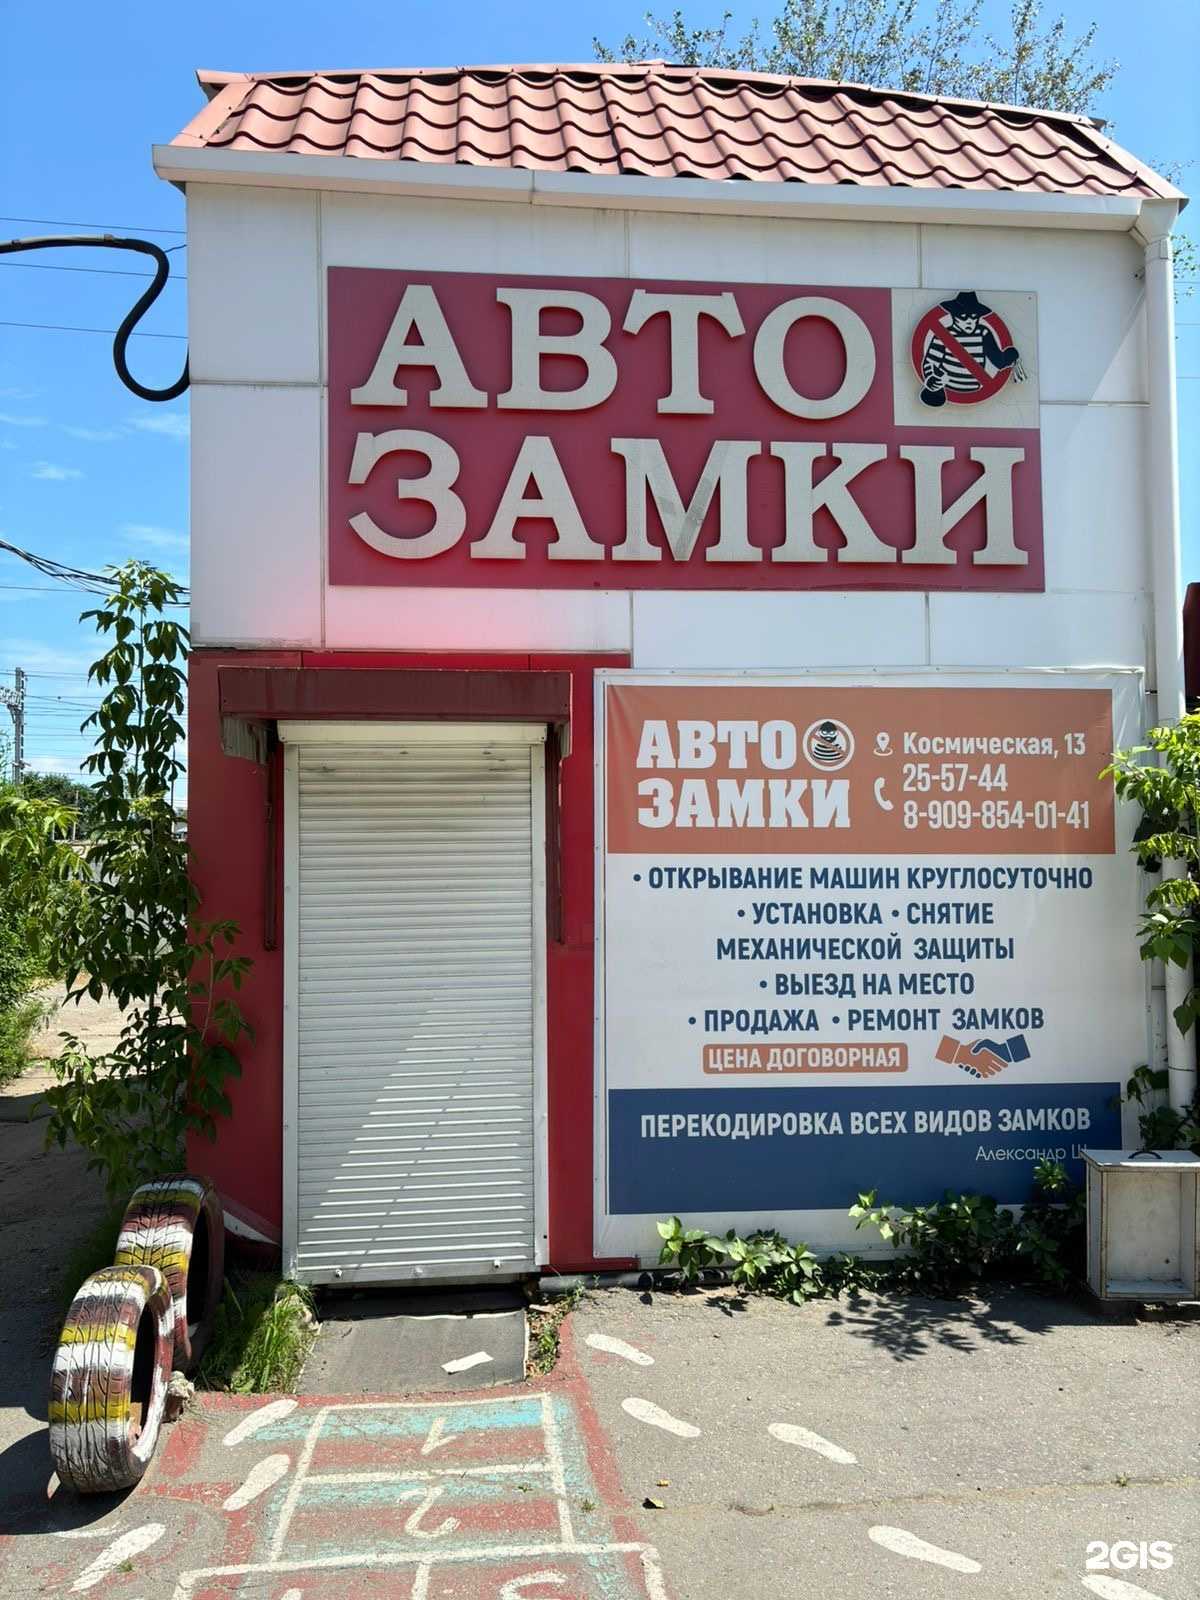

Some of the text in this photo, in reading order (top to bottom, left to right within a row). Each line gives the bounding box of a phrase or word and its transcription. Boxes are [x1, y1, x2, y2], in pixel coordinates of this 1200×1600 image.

[350, 284, 877, 421] АВТО
[348, 428, 1030, 566] ЗАМКИ
[636, 719, 797, 770] АВТО
[903, 731, 1087, 758] Космическая, 13
[902, 763, 1009, 792] 25-57-44
[637, 777, 851, 828] ЗАМКИ
[903, 799, 1090, 830] 8-909-854-01-41
[648, 866, 1093, 890] ОТКРЫВАНИЕ МАШИН КРУГЛОСУТОЧНО
[752, 902, 994, 925] УСТАНОВКА СНЯТИЕ
[716, 932, 1015, 963] МЕХАНИЧЕСКОЙ ЗАЩИТЫ
[775, 972, 975, 999] ВЫЕЗД НА МЕСТО
[704, 1007, 1045, 1035] ПРОДАЖА РЕМОНТ ЗАМКОВ
[708, 1046, 901, 1072] ЦЕНА ДОГОВОРНАЯ
[641, 1107, 1092, 1140] ПЕРЕКОДИРОВКА ВСЕХ ВИДОВ ЗАМКОВ
[975, 1145, 1067, 1162] Александр
